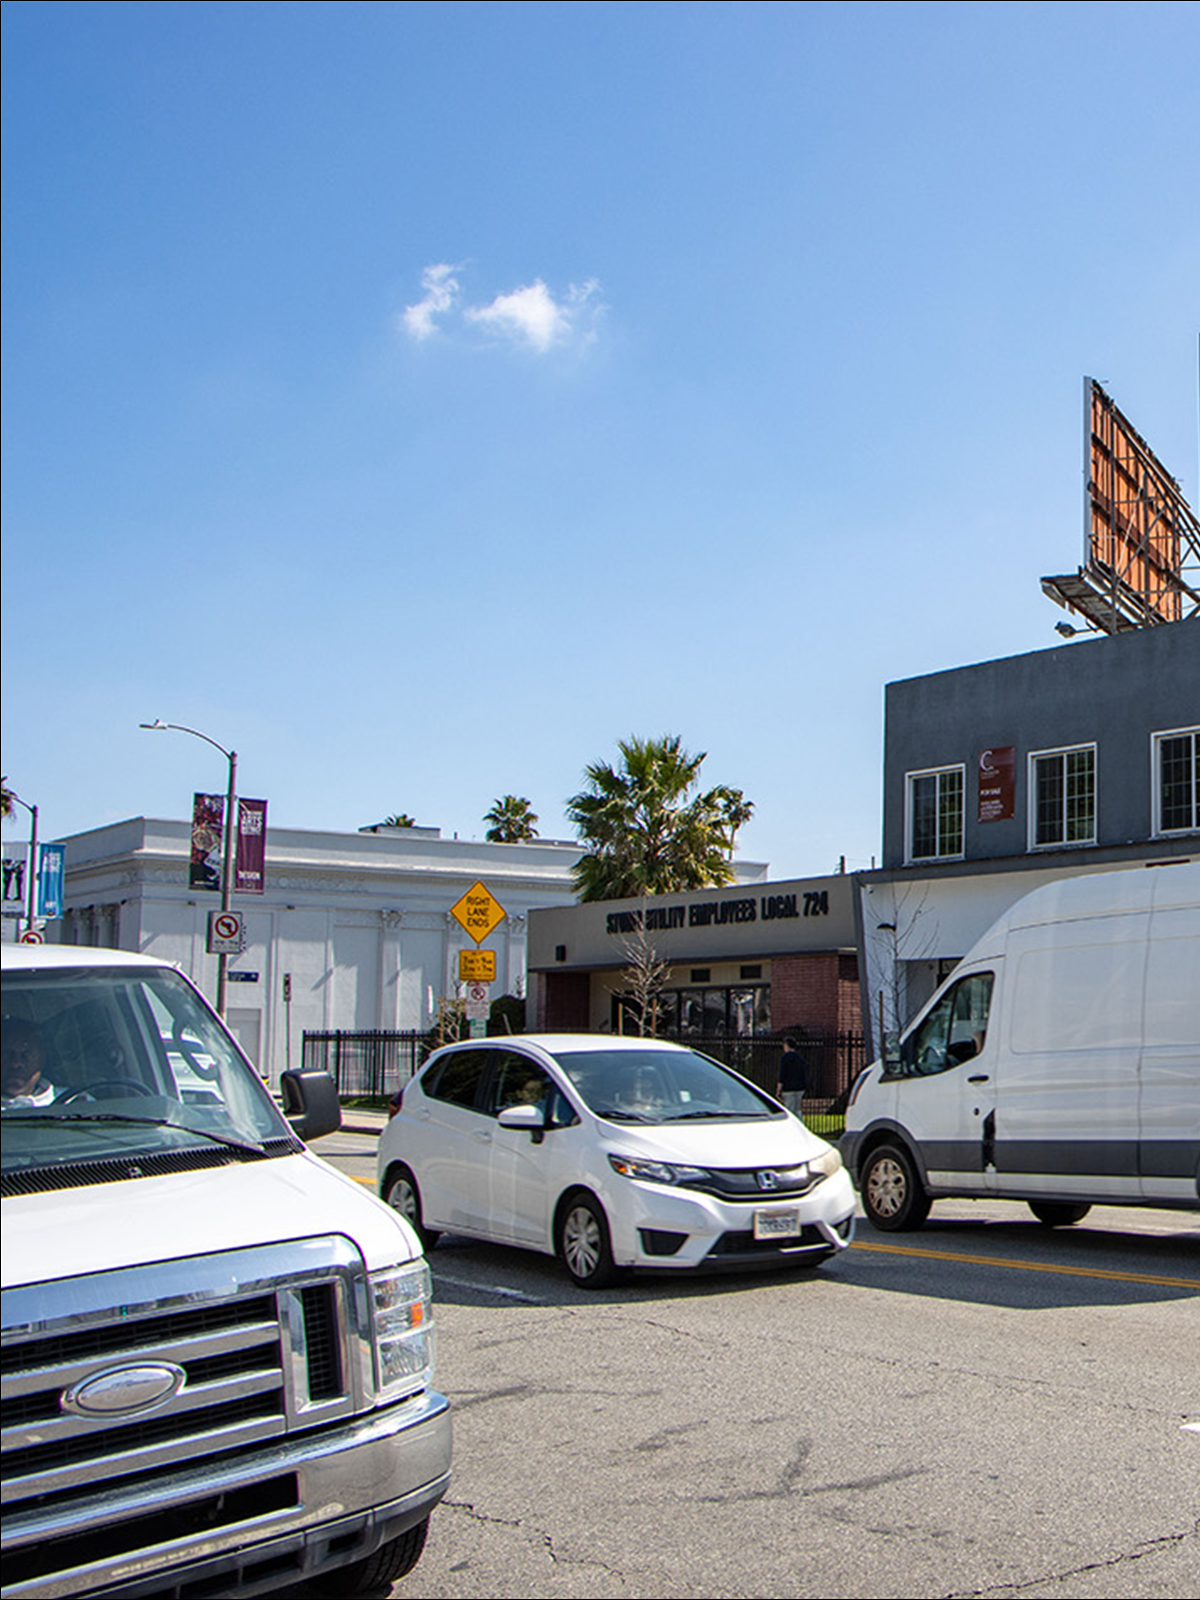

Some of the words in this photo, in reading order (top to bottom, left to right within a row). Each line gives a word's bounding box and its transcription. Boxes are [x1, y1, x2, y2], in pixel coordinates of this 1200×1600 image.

[466, 896, 490, 906] RIGHT
[466, 907, 490, 917] LANE
[688, 898, 757, 927] EMPLOYEES
[761, 893, 799, 921] LOCAL
[803, 890, 829, 917] 724
[466, 917, 490, 928] ENDS
